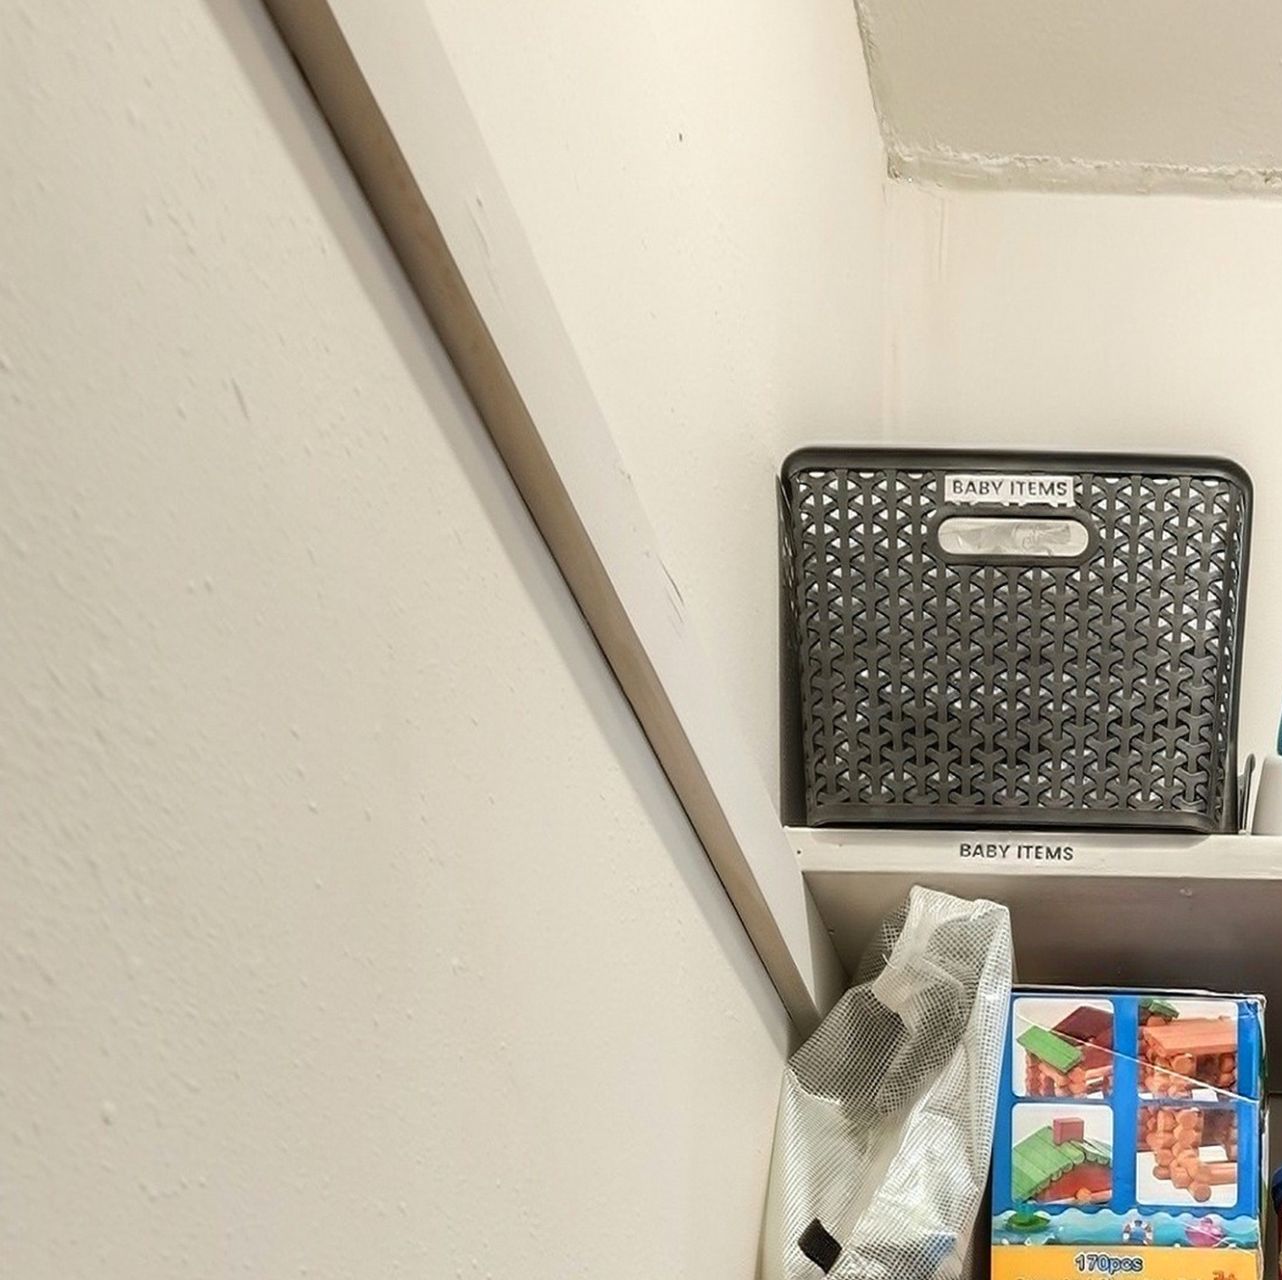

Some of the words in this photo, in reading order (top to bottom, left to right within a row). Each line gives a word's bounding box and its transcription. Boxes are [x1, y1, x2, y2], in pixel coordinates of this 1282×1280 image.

[952, 480, 1003, 495] BABY
[1010, 481, 1067, 496] ITEMS
[960, 843, 1010, 858] BABY
[1017, 845, 1073, 861] ITEMS
[1075, 1253, 1144, 1274] 170pcs
